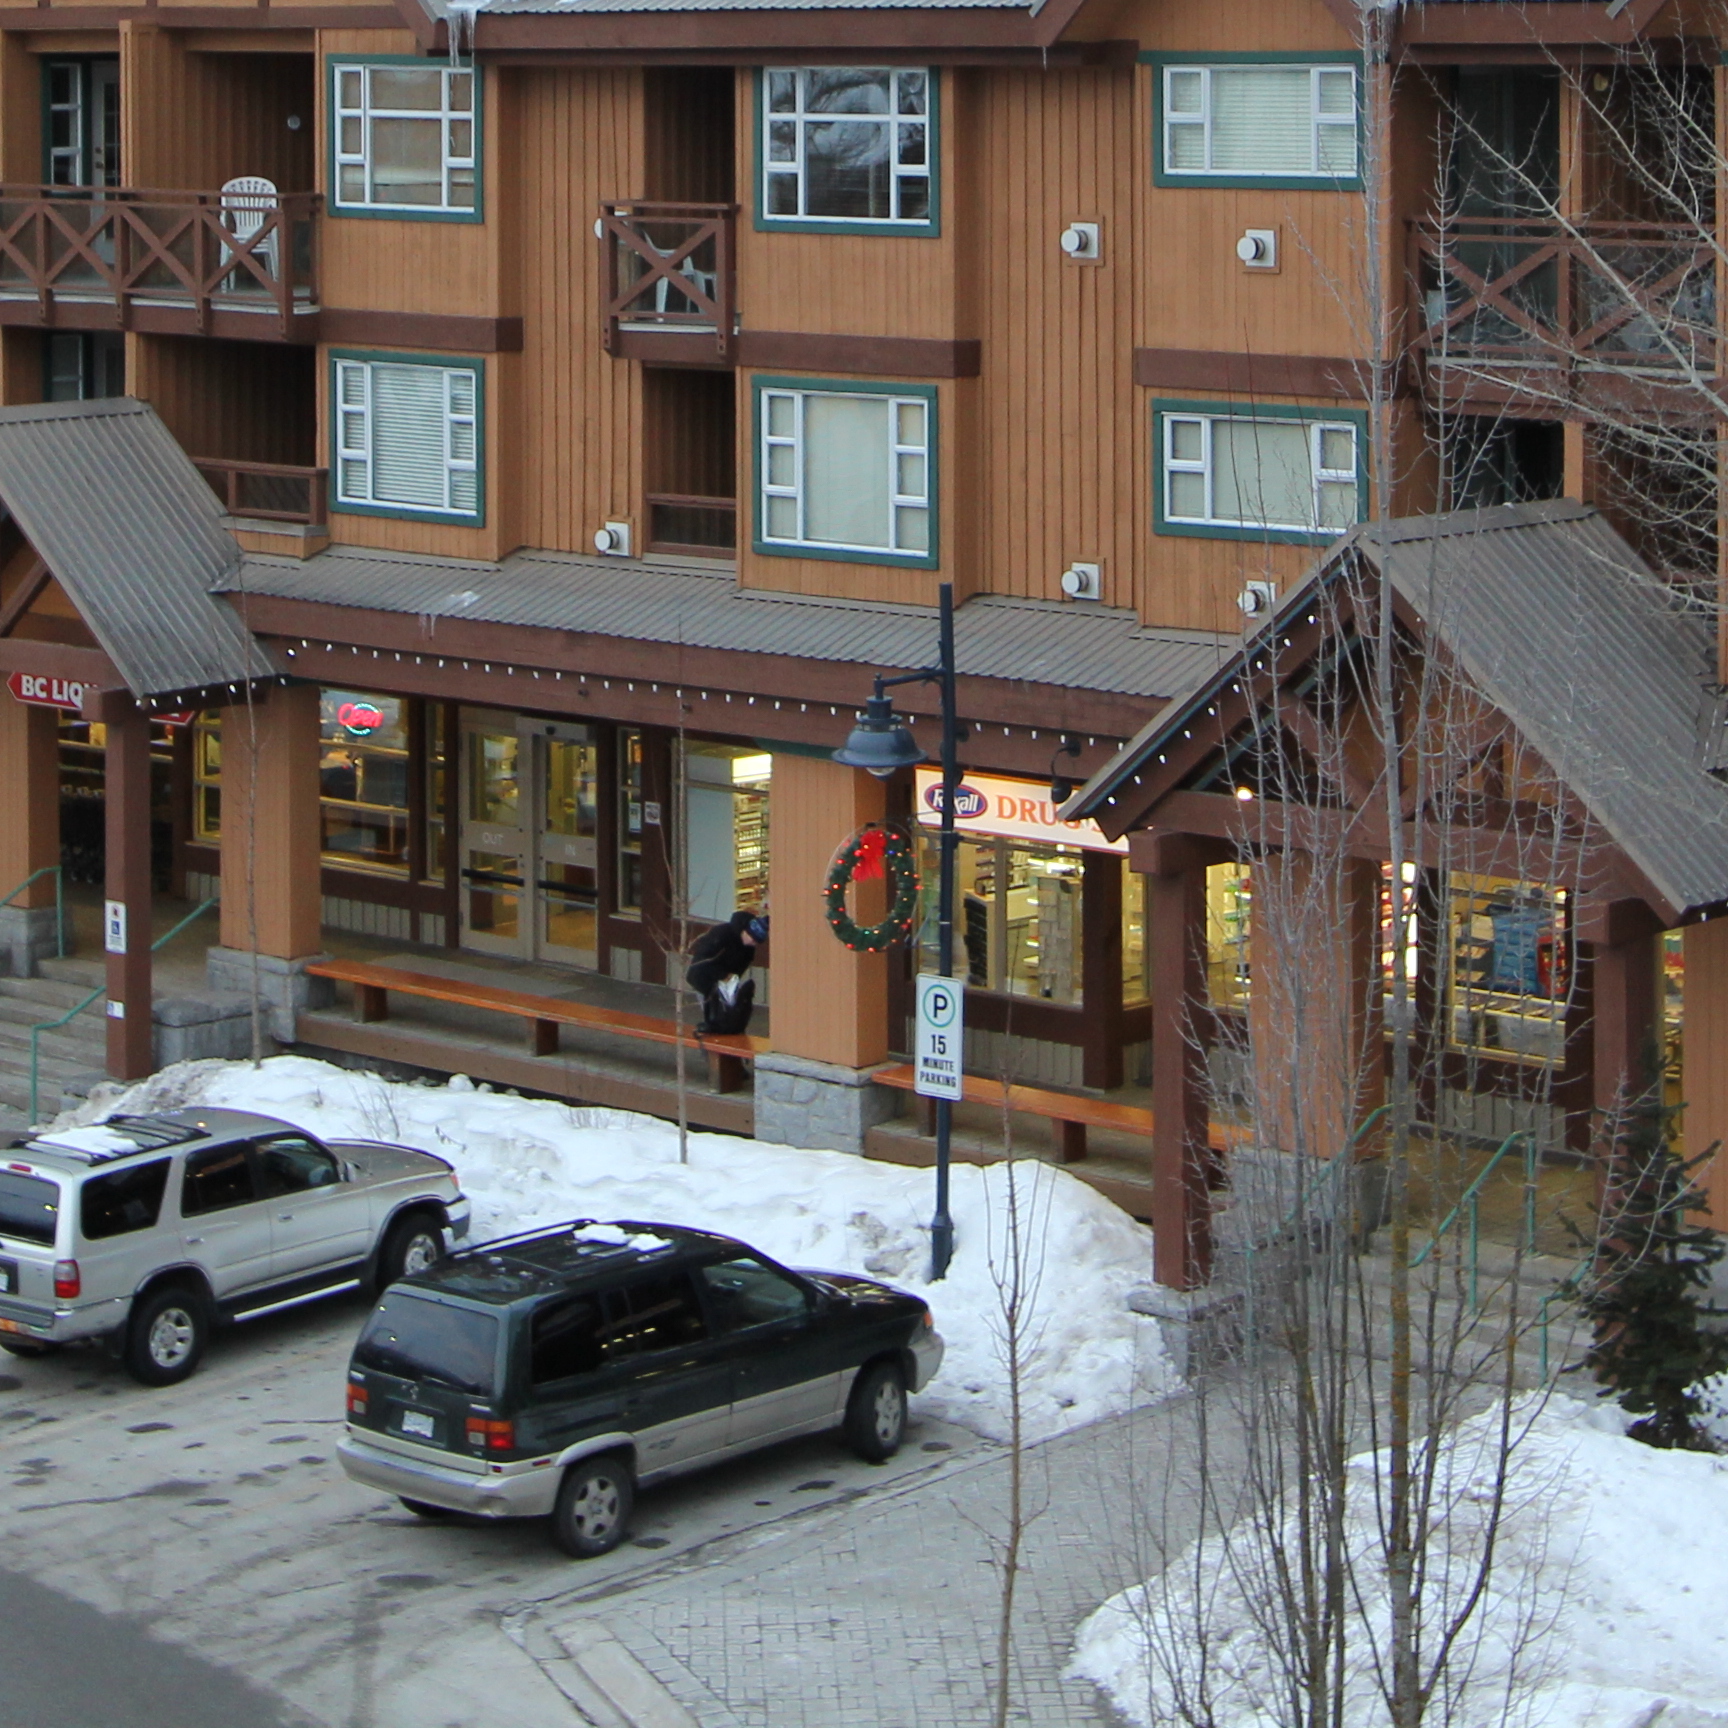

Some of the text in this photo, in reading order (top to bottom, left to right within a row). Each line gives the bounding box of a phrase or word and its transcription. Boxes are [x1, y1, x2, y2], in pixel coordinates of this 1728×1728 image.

[22, 674, 48, 698] BC
[337, 702, 384, 728] Open
[932, 788, 979, 815] Rxall
[996, 795, 1081, 829] DRU
[482, 832, 504, 845] OUT
[934, 993, 948, 1018] P
[931, 1034, 946, 1055] 15
[922, 1056, 954, 1072] MINUTE
[920, 1071, 957, 1088] PARKING
